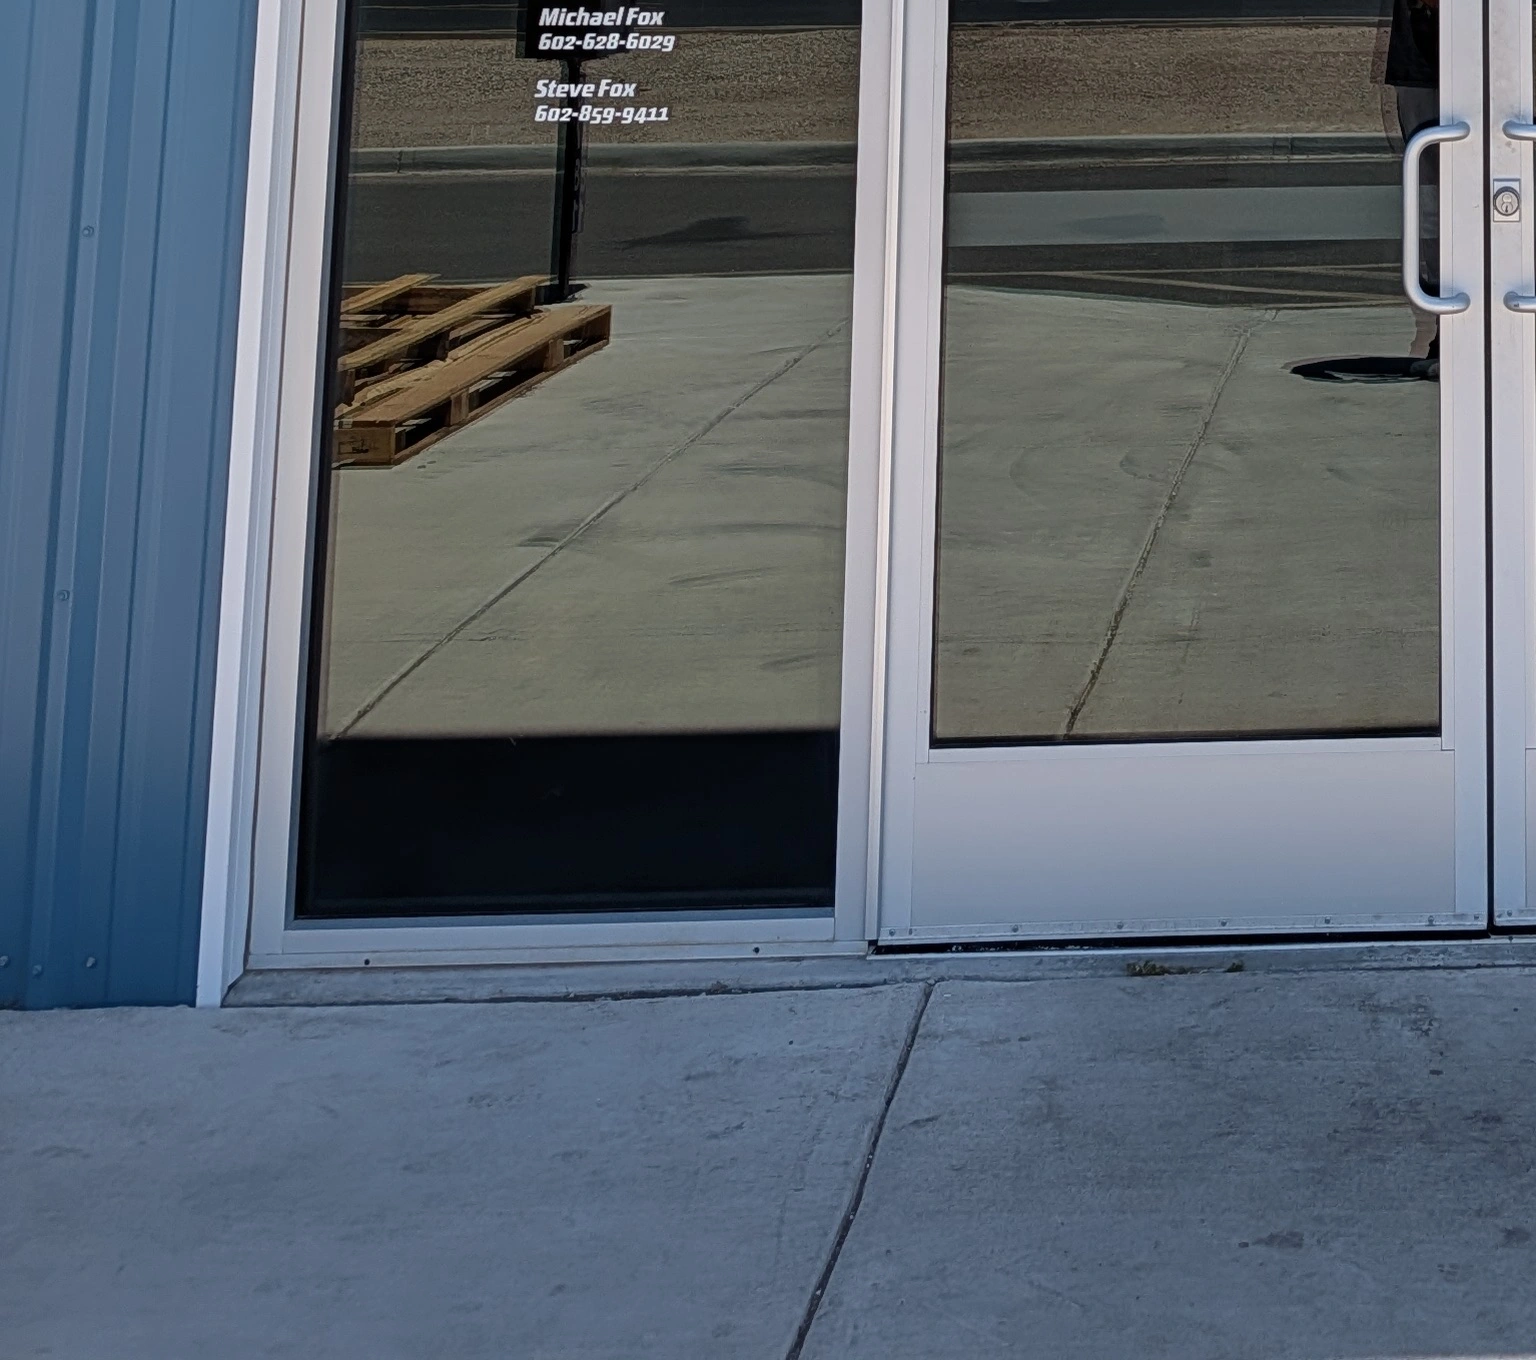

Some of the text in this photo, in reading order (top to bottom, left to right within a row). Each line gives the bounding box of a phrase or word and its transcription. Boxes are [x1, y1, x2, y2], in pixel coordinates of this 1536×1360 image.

[538, 7, 665, 26] Michael Fox
[538, 33, 676, 52] 602-628-6029
[534, 80, 637, 98] Steve Fox
[534, 105, 669, 124] 602-859-9411
